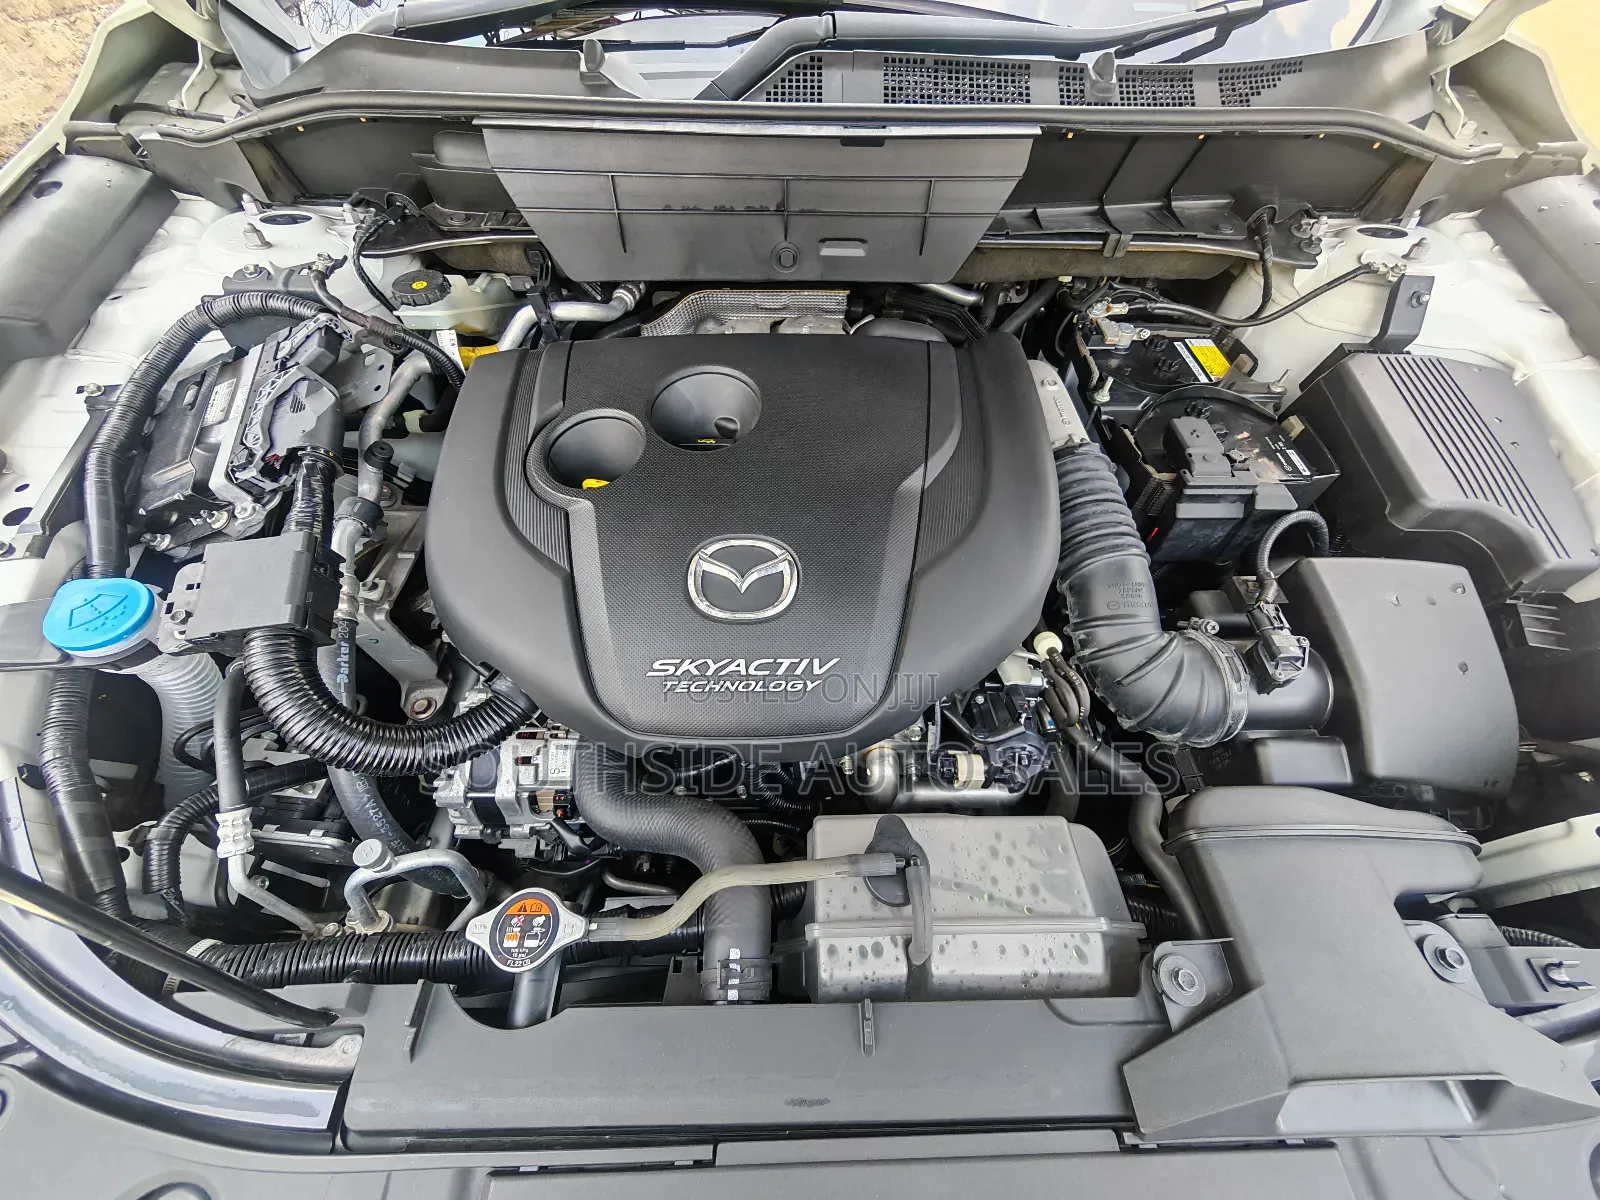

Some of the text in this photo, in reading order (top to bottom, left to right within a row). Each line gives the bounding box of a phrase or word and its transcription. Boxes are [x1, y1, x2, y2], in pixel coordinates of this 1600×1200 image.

[336, 618, 350, 688] Parker 204
[646, 657, 841, 677] SKYACTIV
[662, 680, 822, 693] TECHNOLOGY
